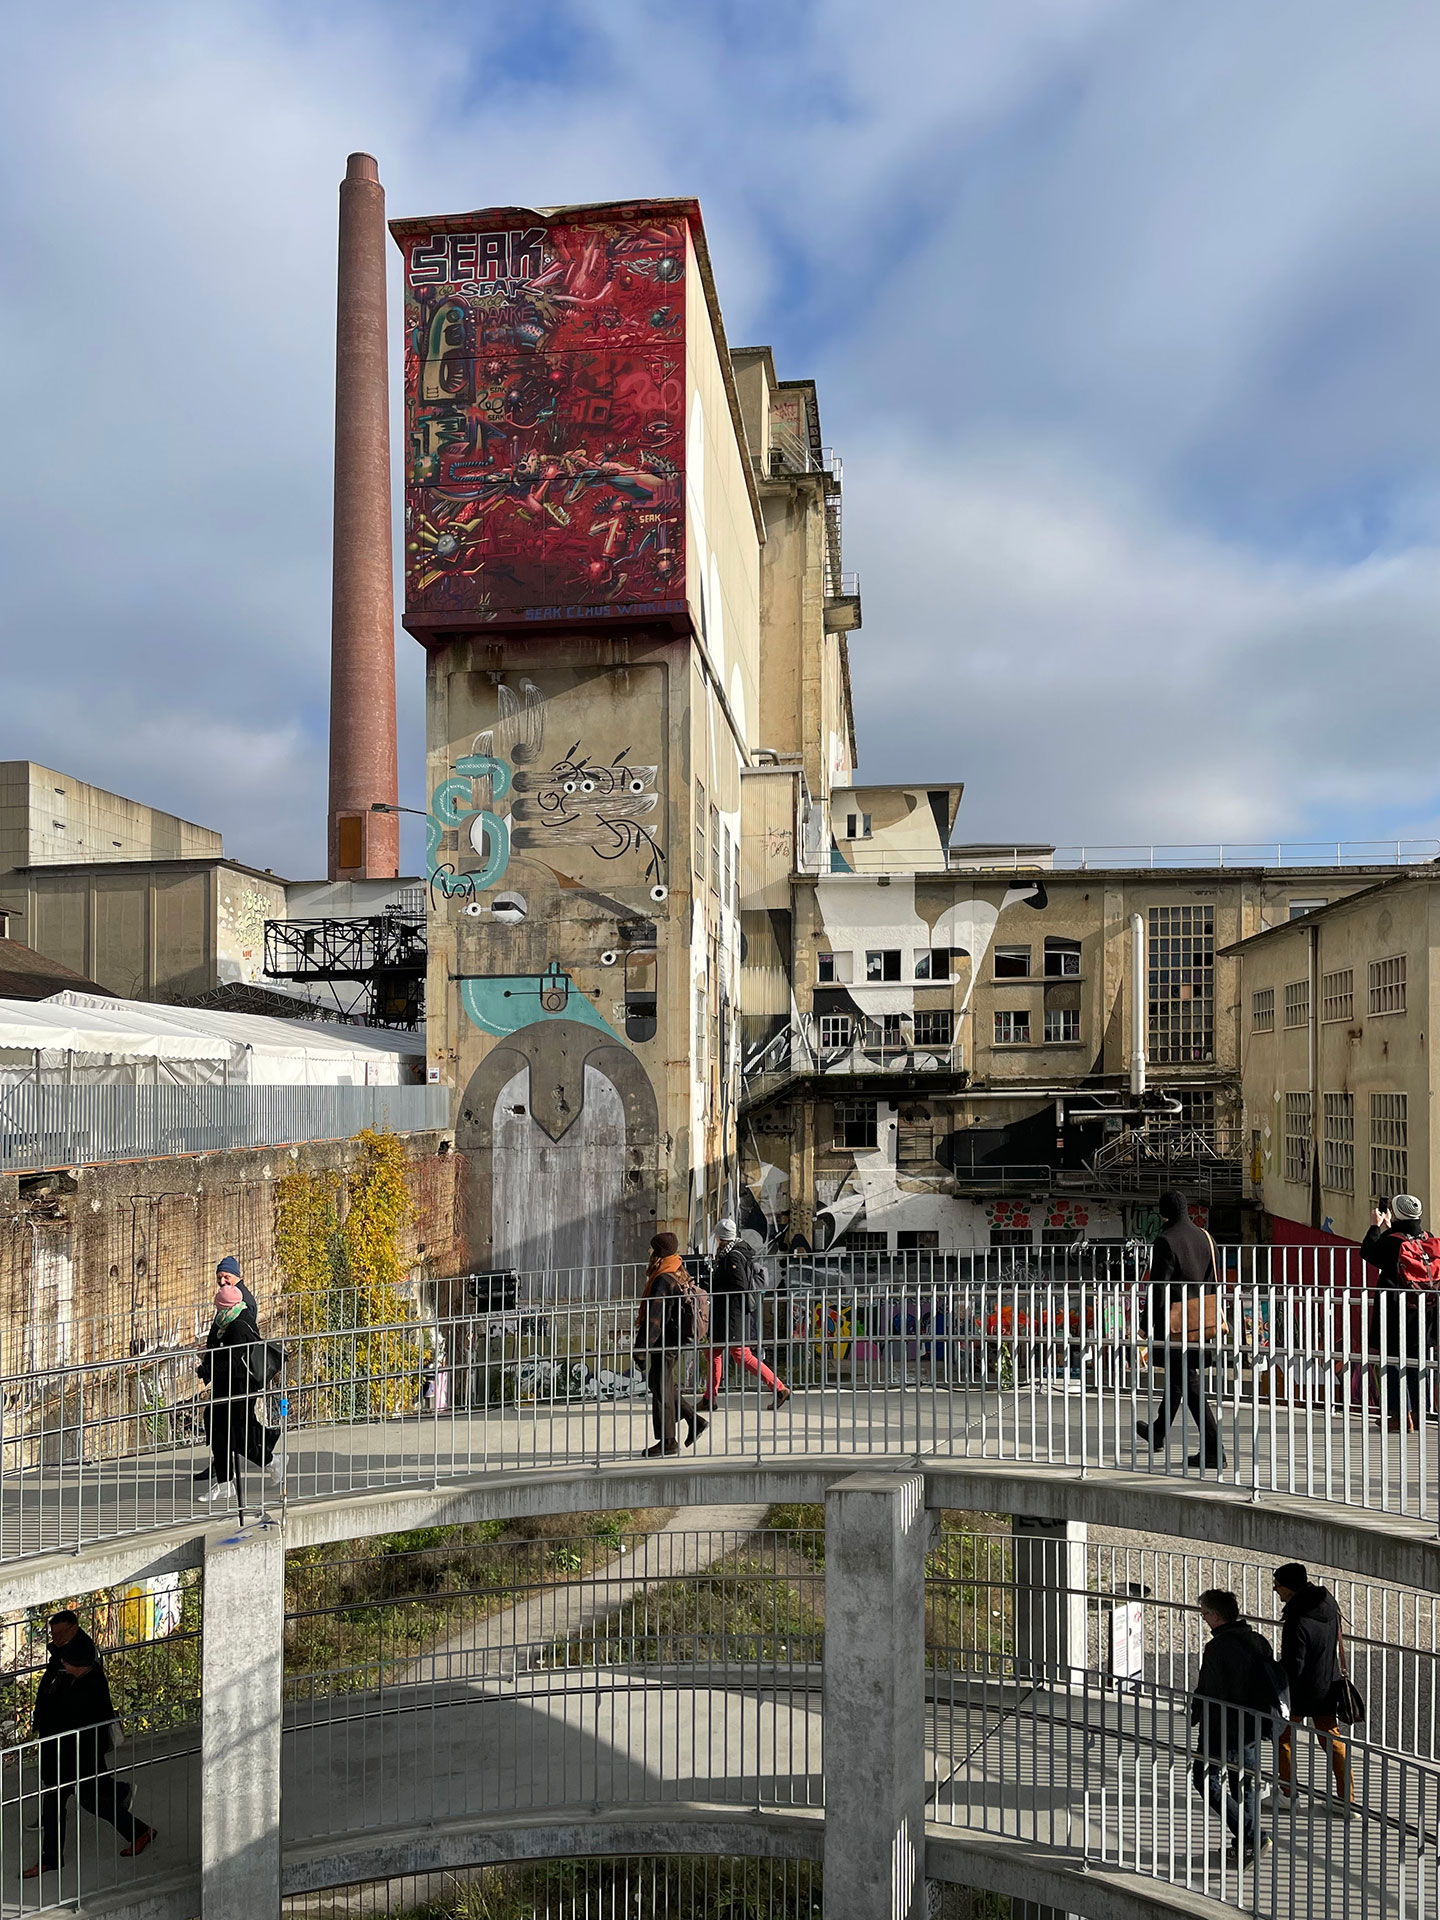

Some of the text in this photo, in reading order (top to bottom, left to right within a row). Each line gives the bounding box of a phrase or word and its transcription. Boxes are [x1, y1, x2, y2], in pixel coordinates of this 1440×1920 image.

[409, 227, 548, 287] SEAK
[456, 278, 544, 298] SEAK
[475, 306, 534, 323] DANKE
[639, 513, 661, 523] SEAK
[525, 608, 562, 620] SEAK
